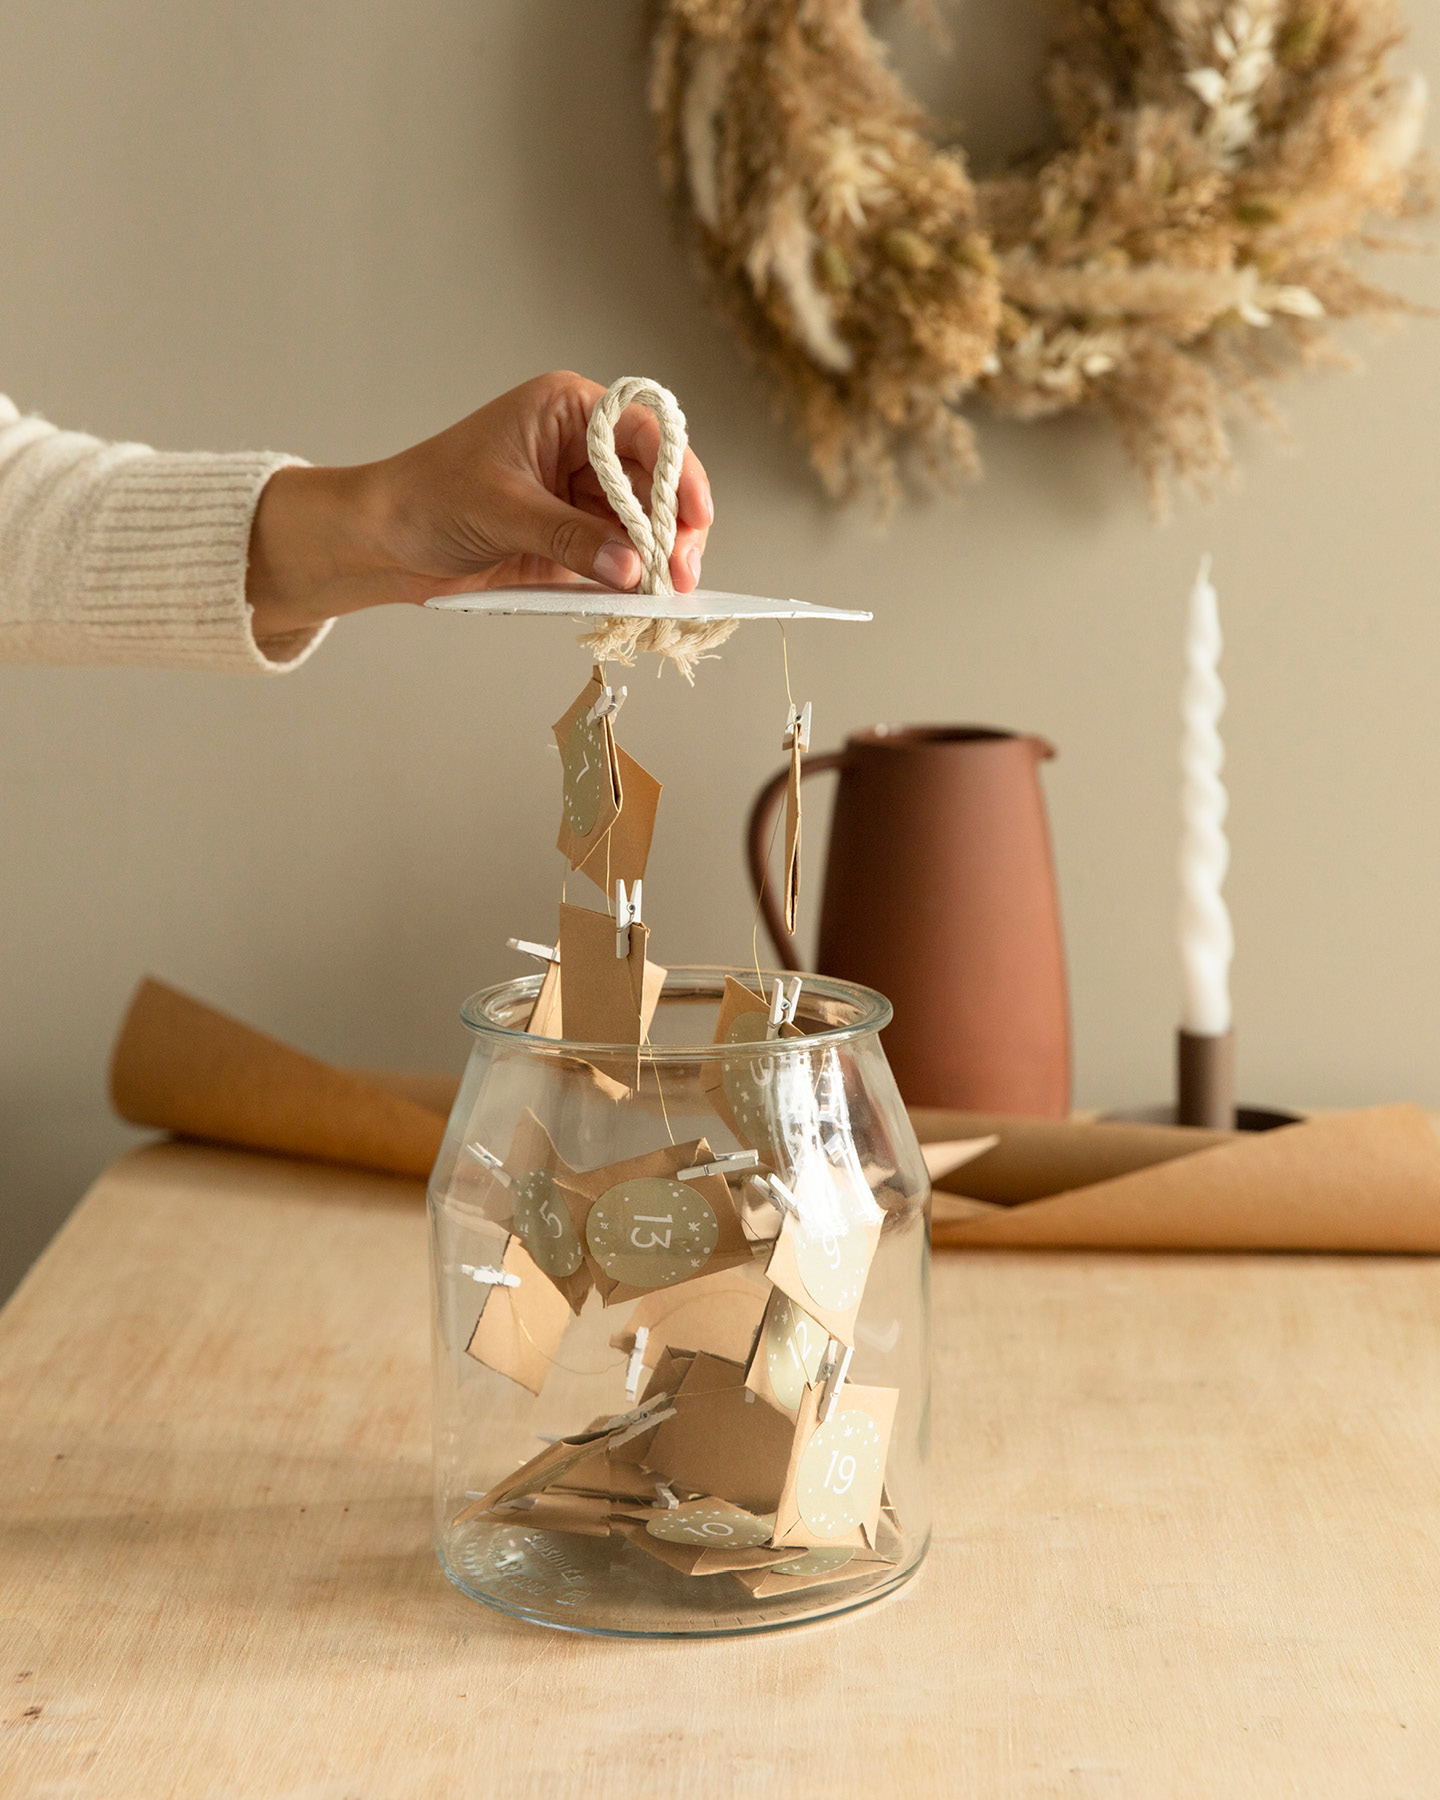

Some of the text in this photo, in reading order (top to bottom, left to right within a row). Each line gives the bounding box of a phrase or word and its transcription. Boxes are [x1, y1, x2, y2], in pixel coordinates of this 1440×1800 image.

[539, 1200, 562, 1238] 5
[630, 1214, 673, 1249] 13
[786, 1320, 812, 1369] 12
[823, 1450, 856, 1494] 19
[682, 1522, 734, 1537] 10
